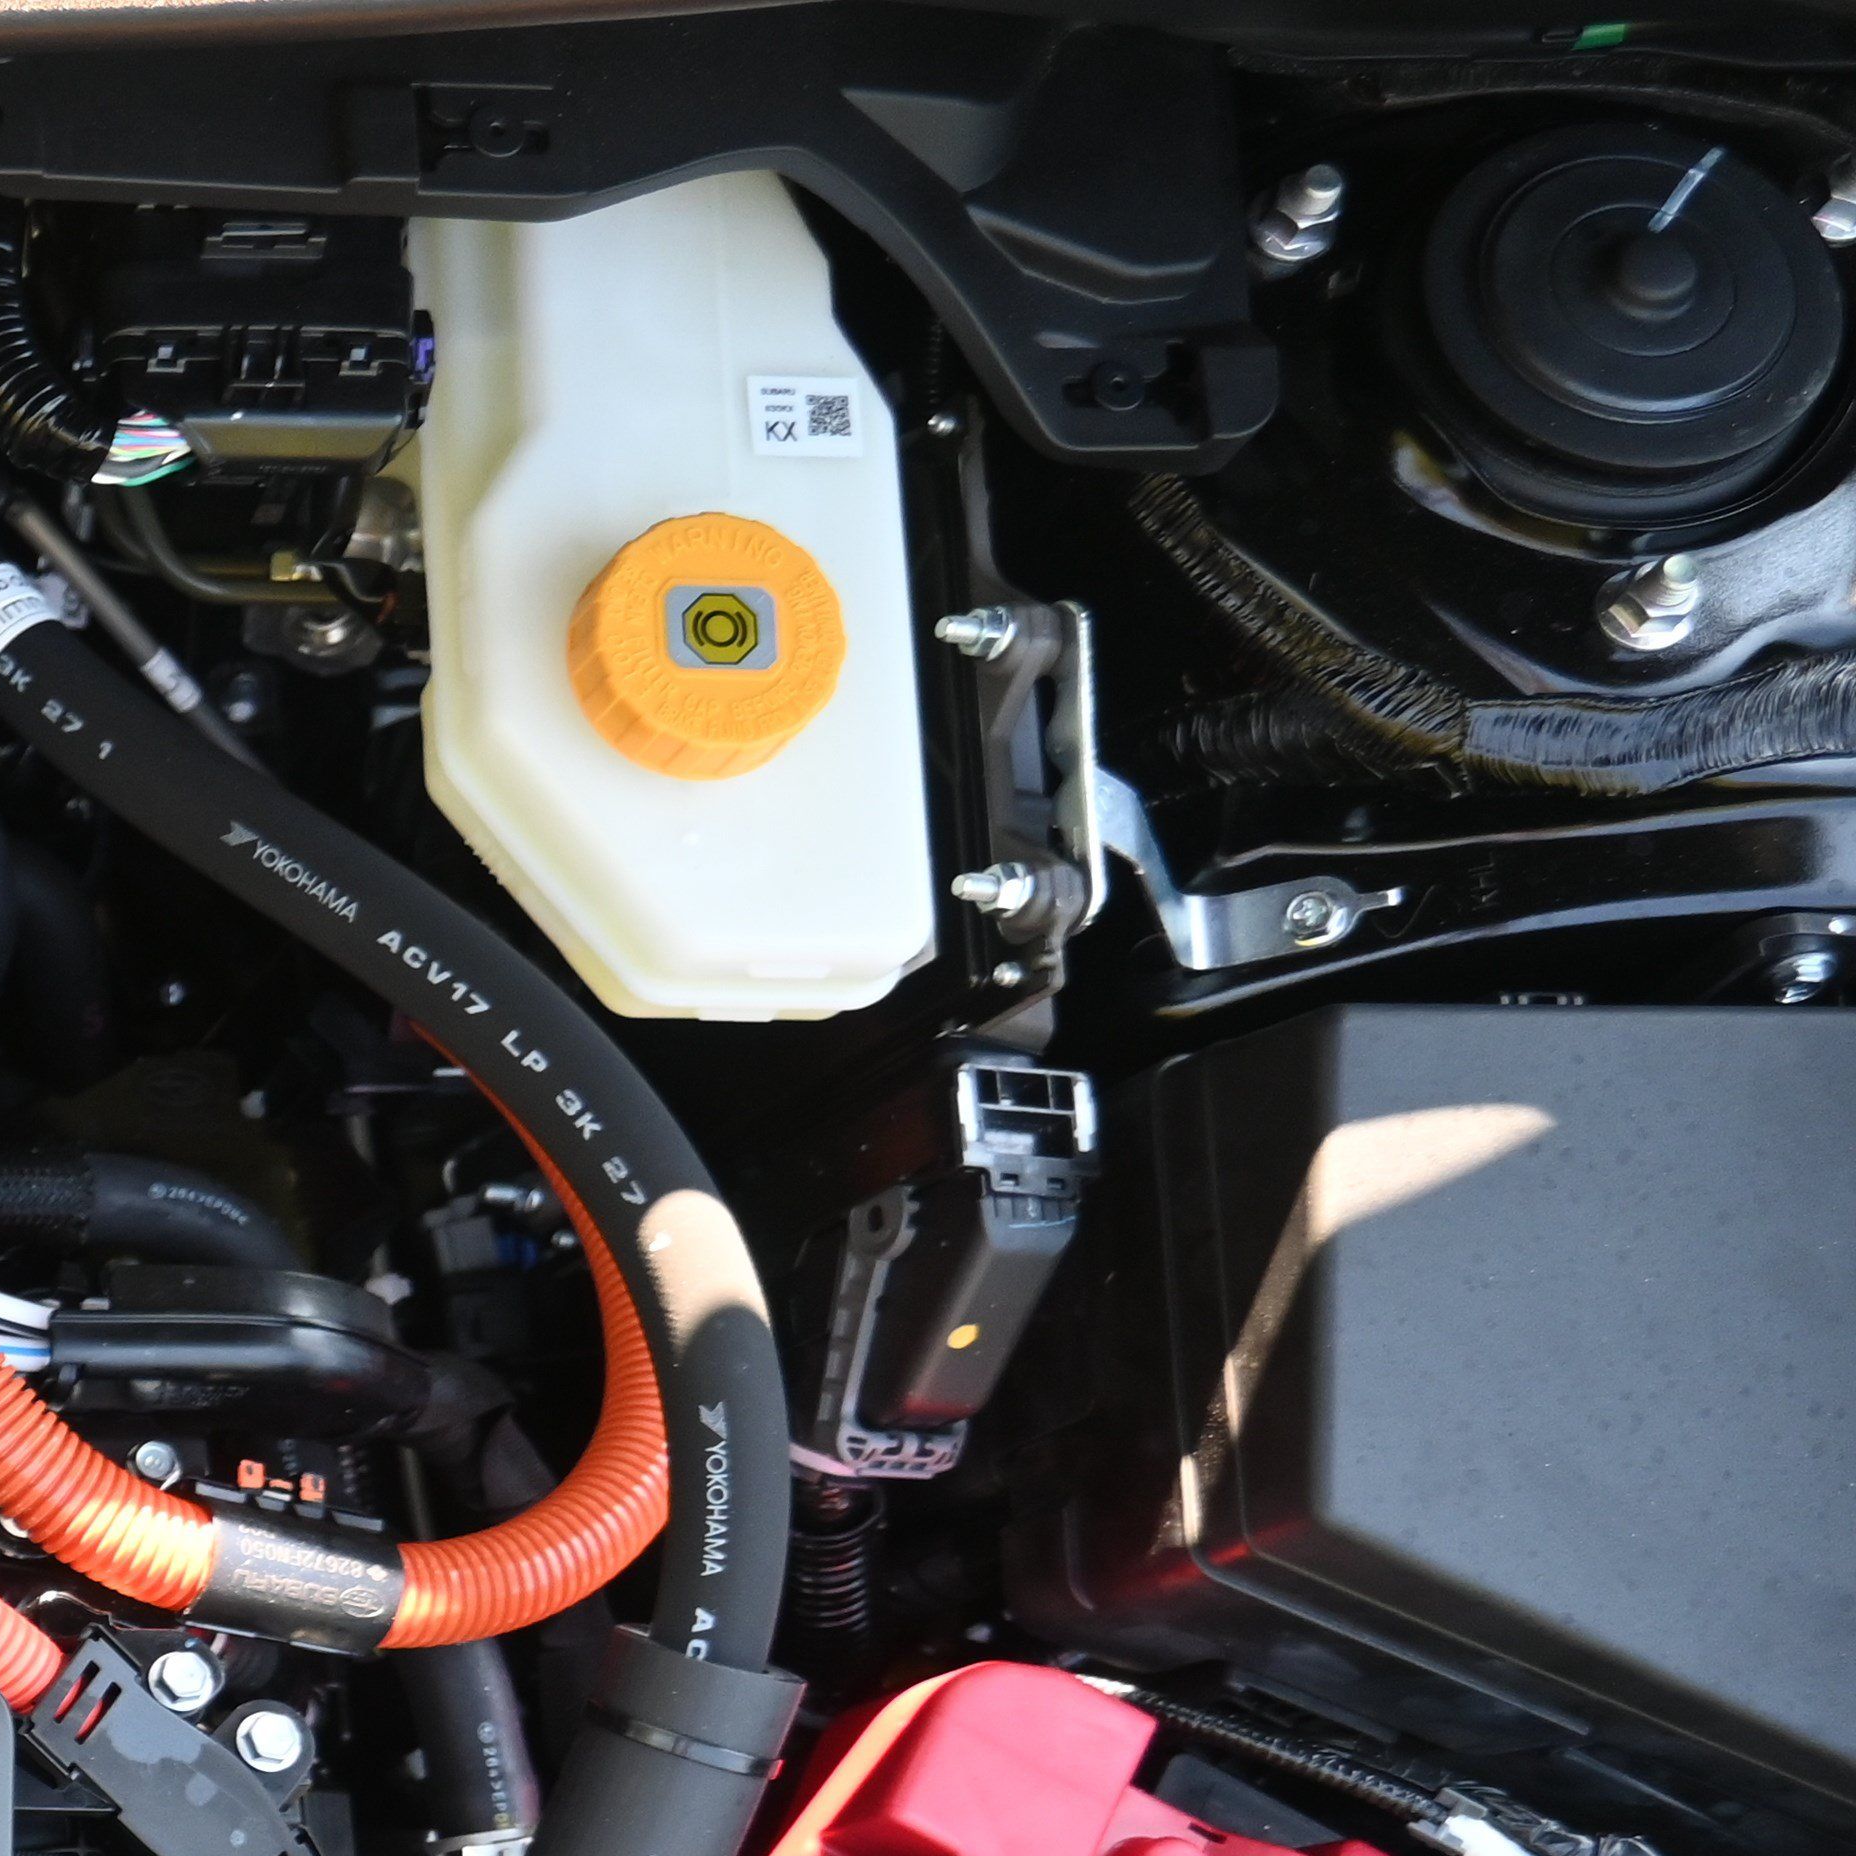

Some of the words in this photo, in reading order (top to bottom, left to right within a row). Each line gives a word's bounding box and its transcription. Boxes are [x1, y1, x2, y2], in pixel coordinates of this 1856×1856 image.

[764, 420, 798, 442] KX
[38, 694, 86, 739] 27
[246, 824, 365, 936] YOKOHAMA
[374, 911, 492, 1036] ACV17
[497, 1025, 551, 1081] LP
[549, 1084, 606, 1144] 3K
[602, 1155, 645, 1208] 27
[688, 1440, 739, 1577] YOKOHAMA
[229, 1567, 340, 1606] SUBARU
